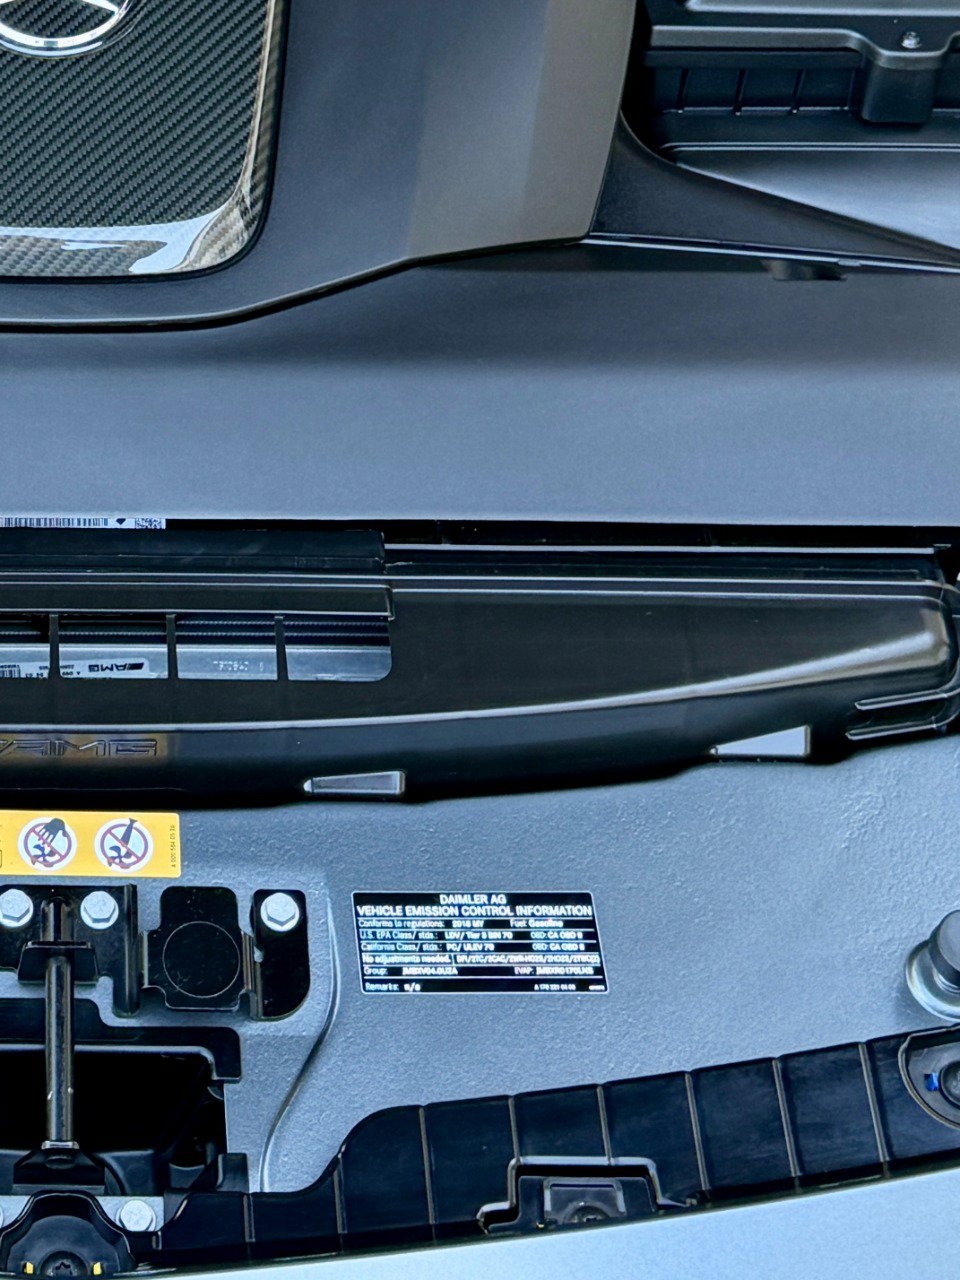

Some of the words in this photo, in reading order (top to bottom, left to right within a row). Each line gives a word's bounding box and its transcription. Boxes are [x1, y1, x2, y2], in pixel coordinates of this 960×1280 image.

[87, 664, 128, 673] AMG
[440, 894, 488, 904] DAIMLER
[490, 895, 507, 904] AG
[357, 906, 403, 916] VEHICLE
[405, 906, 458, 916] EMISSION
[461, 906, 514, 916] CONTROL
[516, 906, 591, 916] INFORMATION
[528, 919, 564, 928] Gasoline
